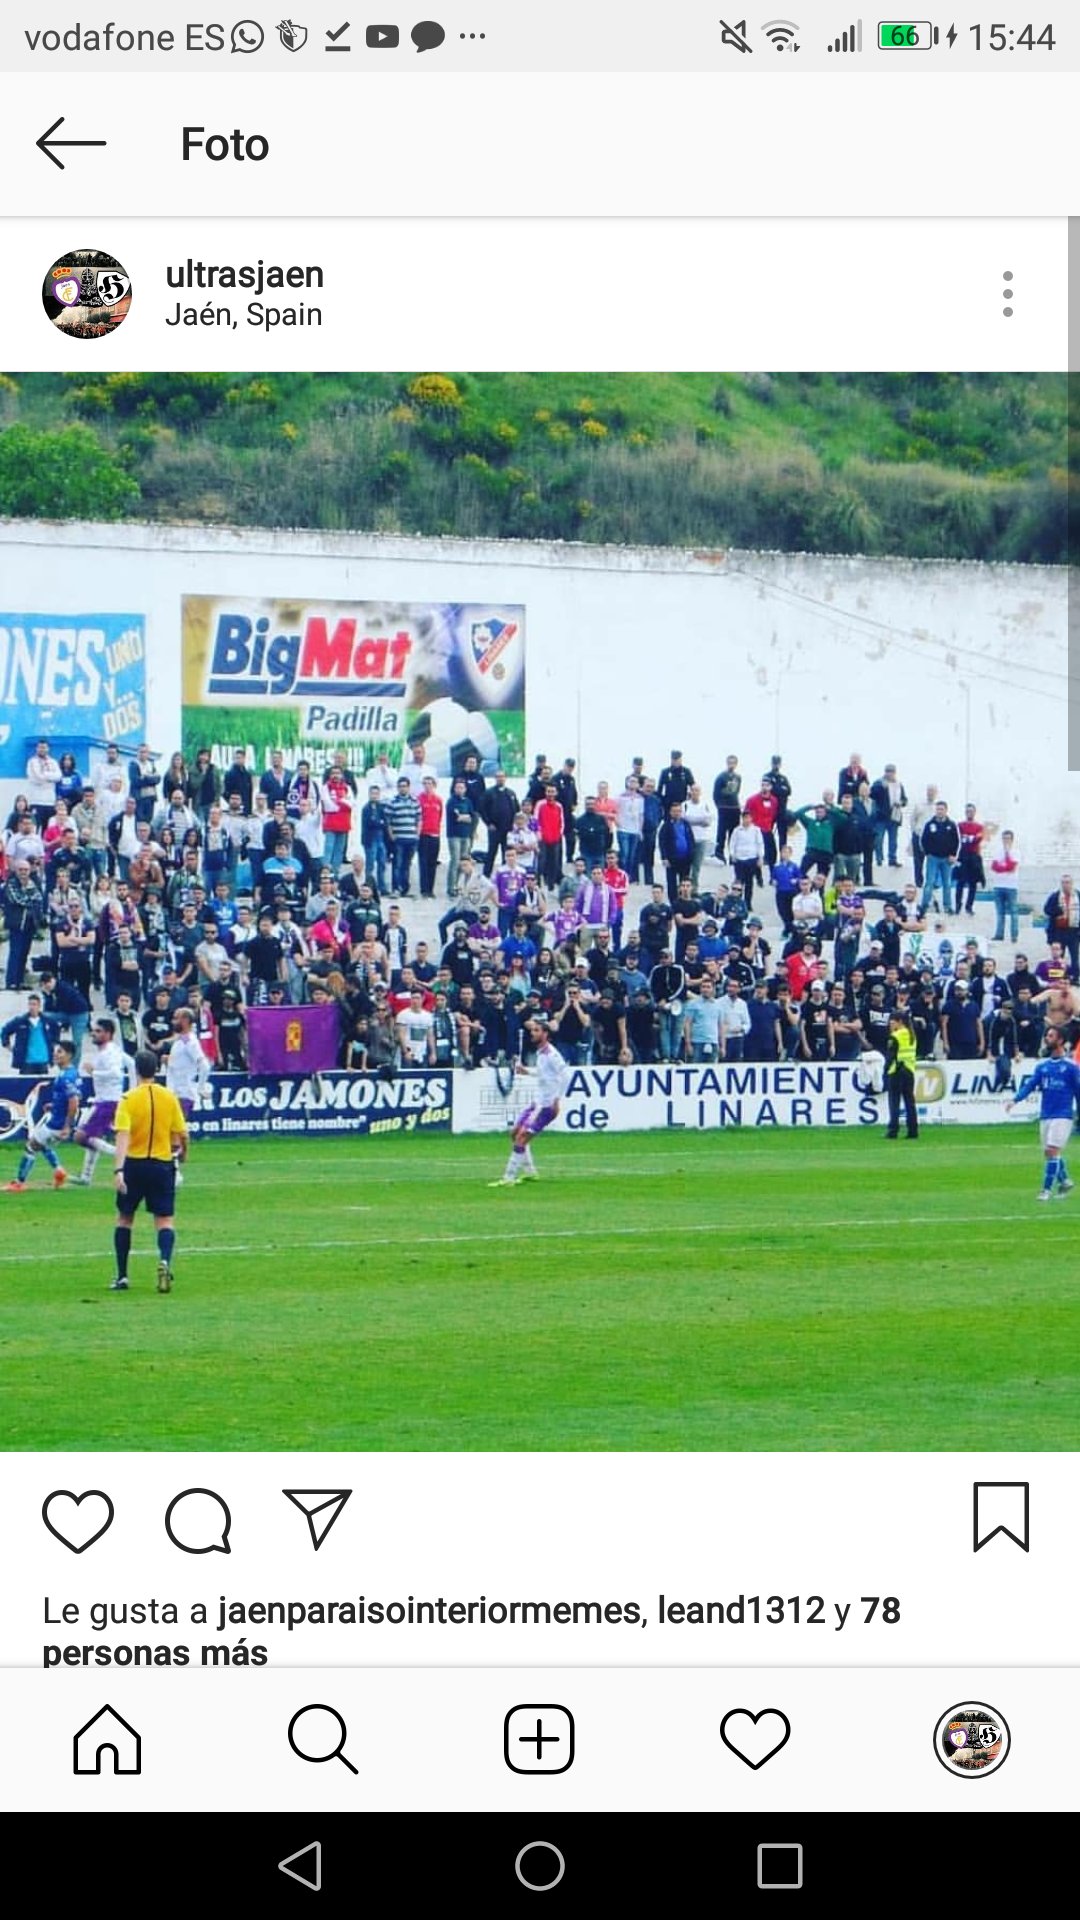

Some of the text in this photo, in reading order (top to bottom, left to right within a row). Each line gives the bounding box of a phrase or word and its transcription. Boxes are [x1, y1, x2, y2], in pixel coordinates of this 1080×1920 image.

[24, 22, 225, 52] vodafone ES
[890, 25, 920, 46] 66
[969, 23, 1057, 51] 15:44
[182, 126, 270, 162] Foto
[166, 258, 324, 296] ultrasjaen
[166, 300, 322, 332] Jaén, Spain
[211, 614, 411, 695] BigMat
[102, 700, 142, 741] DOS
[307, 705, 398, 732] Padilla
[219, 1086, 268, 1109] LOS
[269, 1078, 447, 1110] JAMONES
[202, 1121, 219, 1131] en
[222, 1117, 269, 1131] linares
[271, 1116, 305, 1130] tiene
[369, 1116, 402, 1134] uno
[420, 1106, 451, 1125] dos
[566, 1097, 879, 1129] de LINARES
[44, 1594, 901, 1632] Le gusta a jaenparaisointeriormemes, leand1312 y 78
[43, 1637, 269, 1668] personas más
